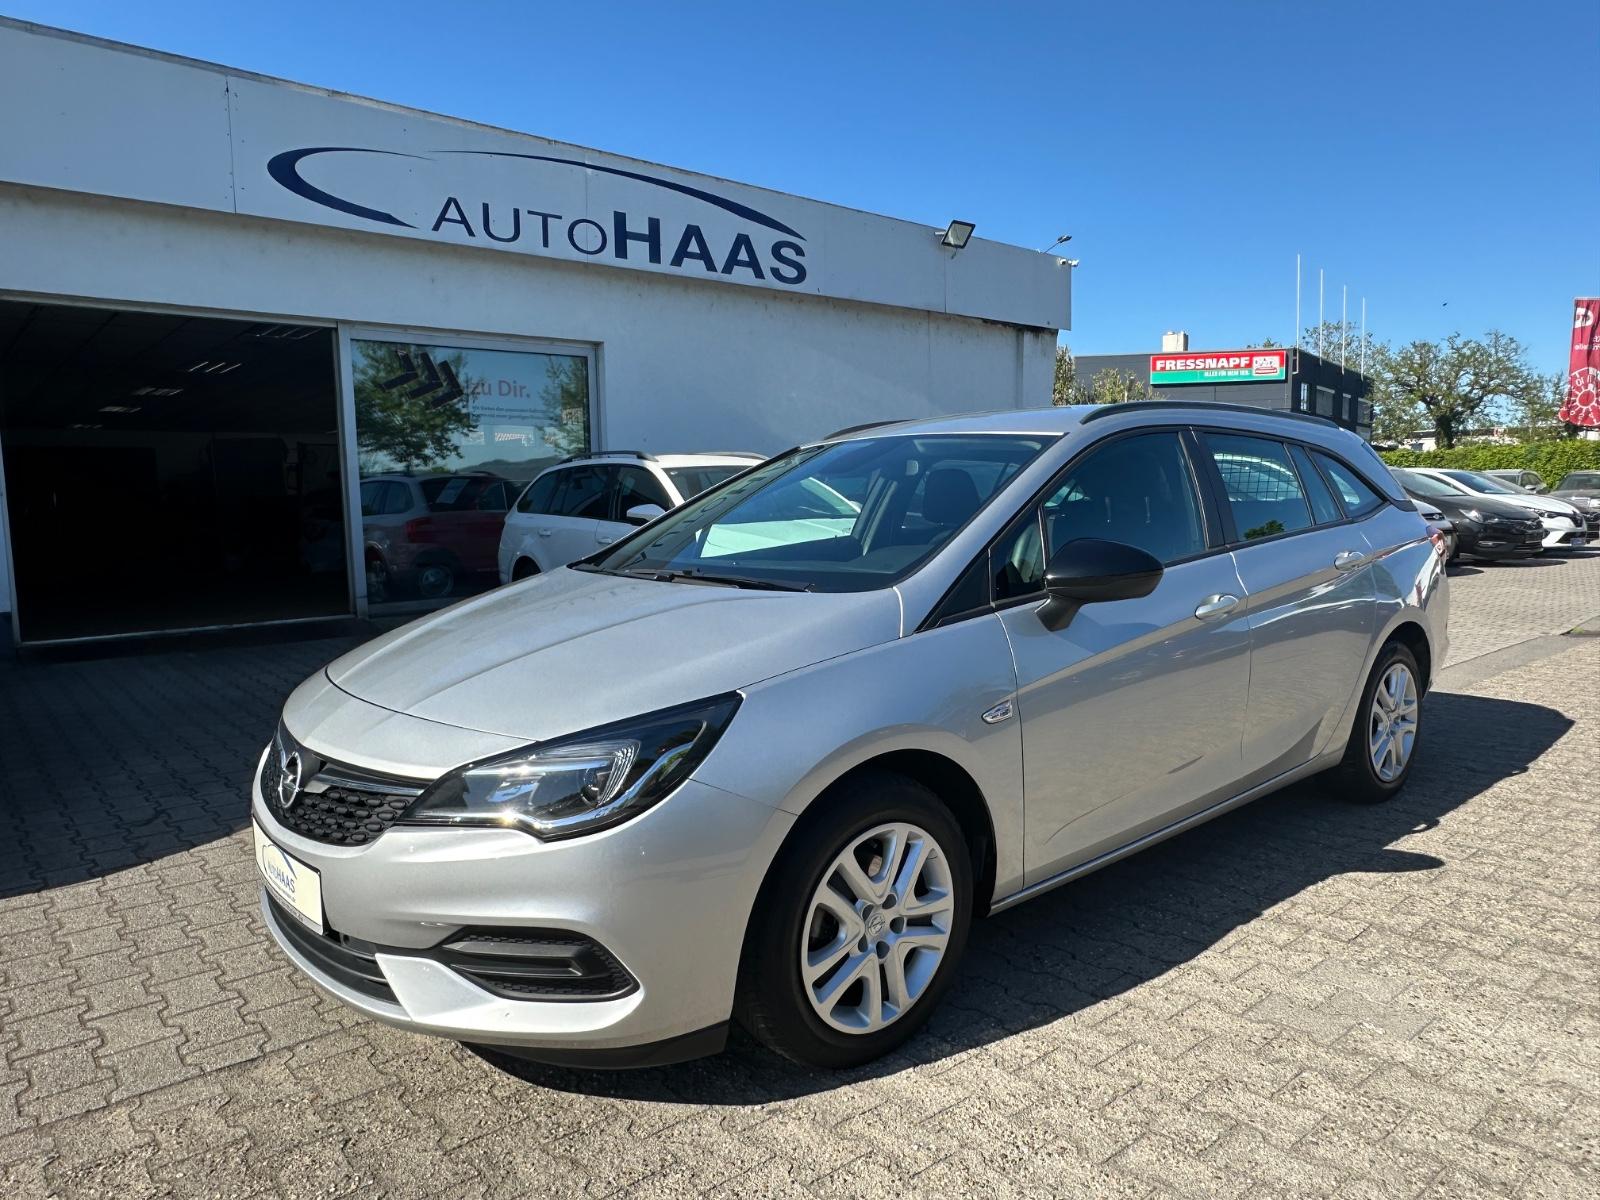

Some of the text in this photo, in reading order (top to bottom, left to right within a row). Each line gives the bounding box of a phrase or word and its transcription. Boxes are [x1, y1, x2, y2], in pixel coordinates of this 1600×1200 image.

[431, 196, 807, 285] AUTOHAAS
[1155, 356, 1251, 371] FRESSNAPF
[498, 379, 531, 399] Dir.
